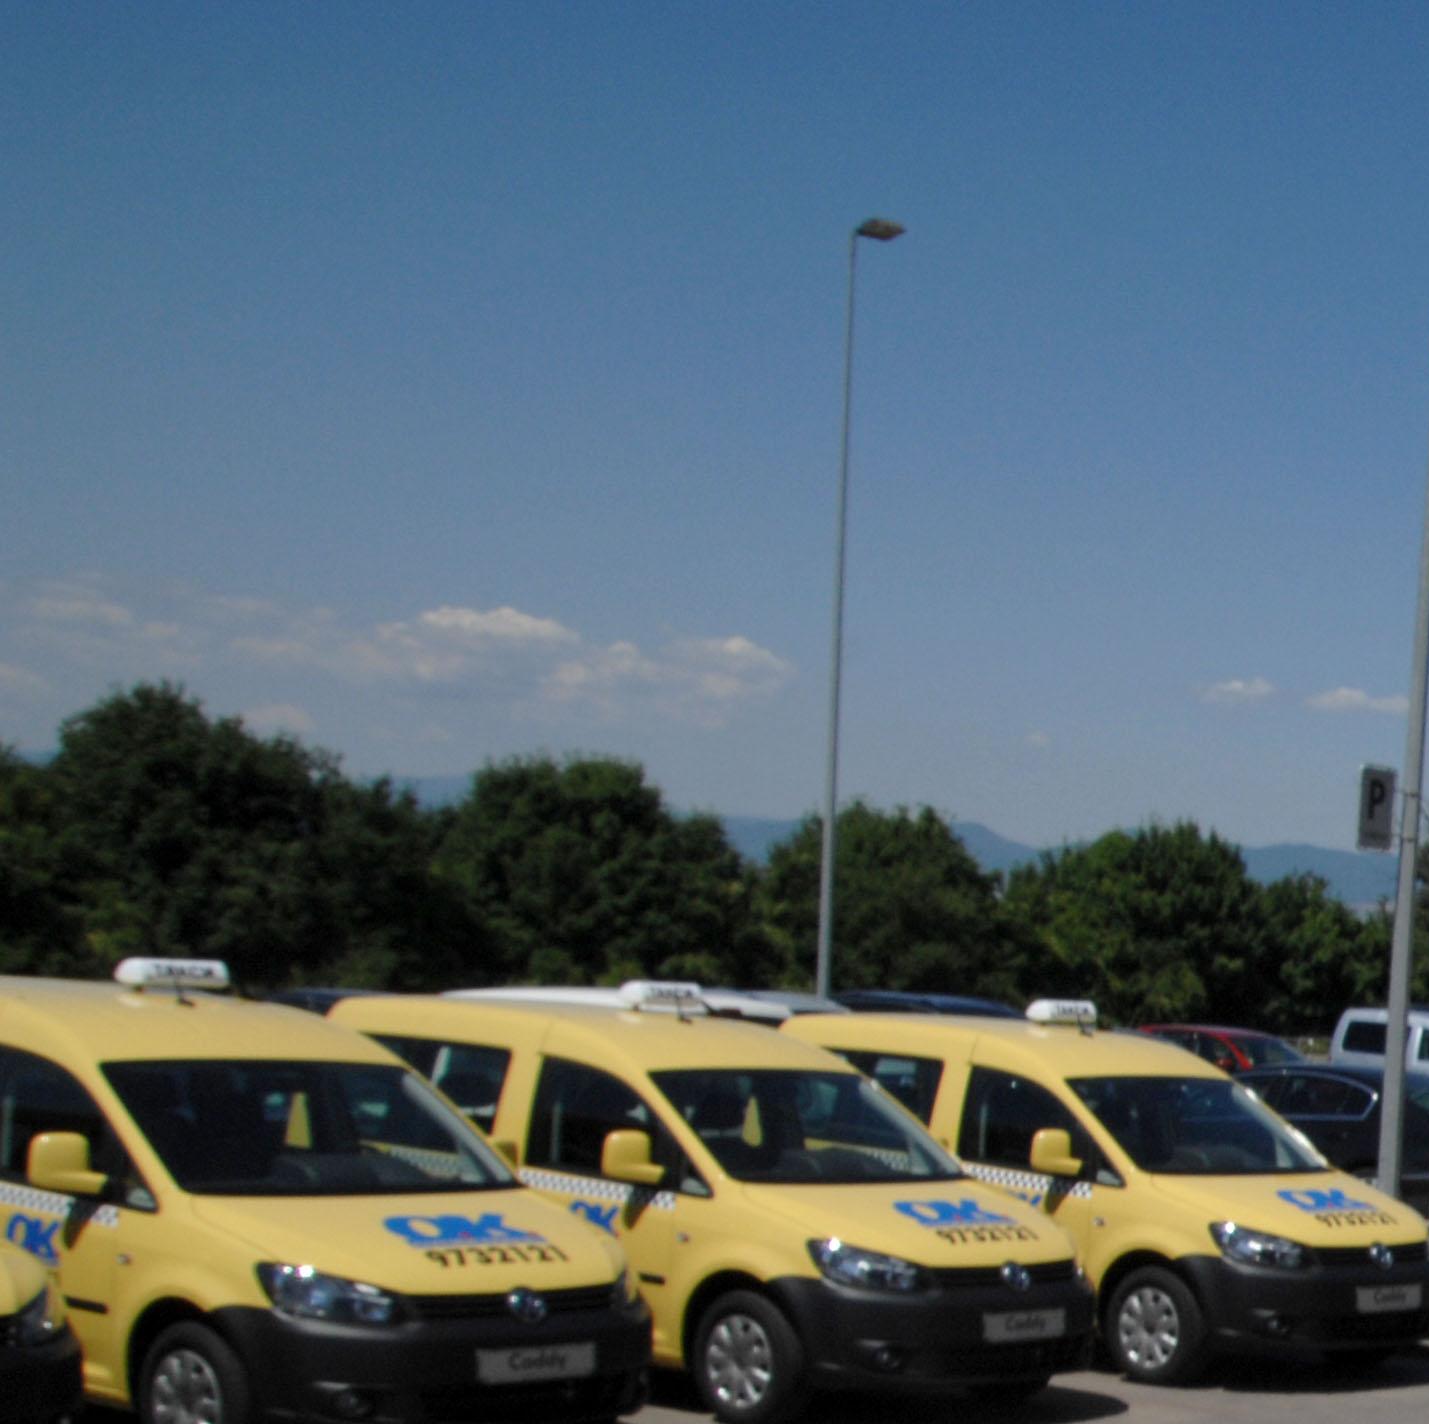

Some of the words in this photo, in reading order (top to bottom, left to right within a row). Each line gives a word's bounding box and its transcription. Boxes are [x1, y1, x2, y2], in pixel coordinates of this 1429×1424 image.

[1367, 779, 1385, 819] P
[384, 1213, 547, 1246] OK
[426, 1245, 569, 1267] 9732121
[508, 1350, 567, 1371] Caddy
